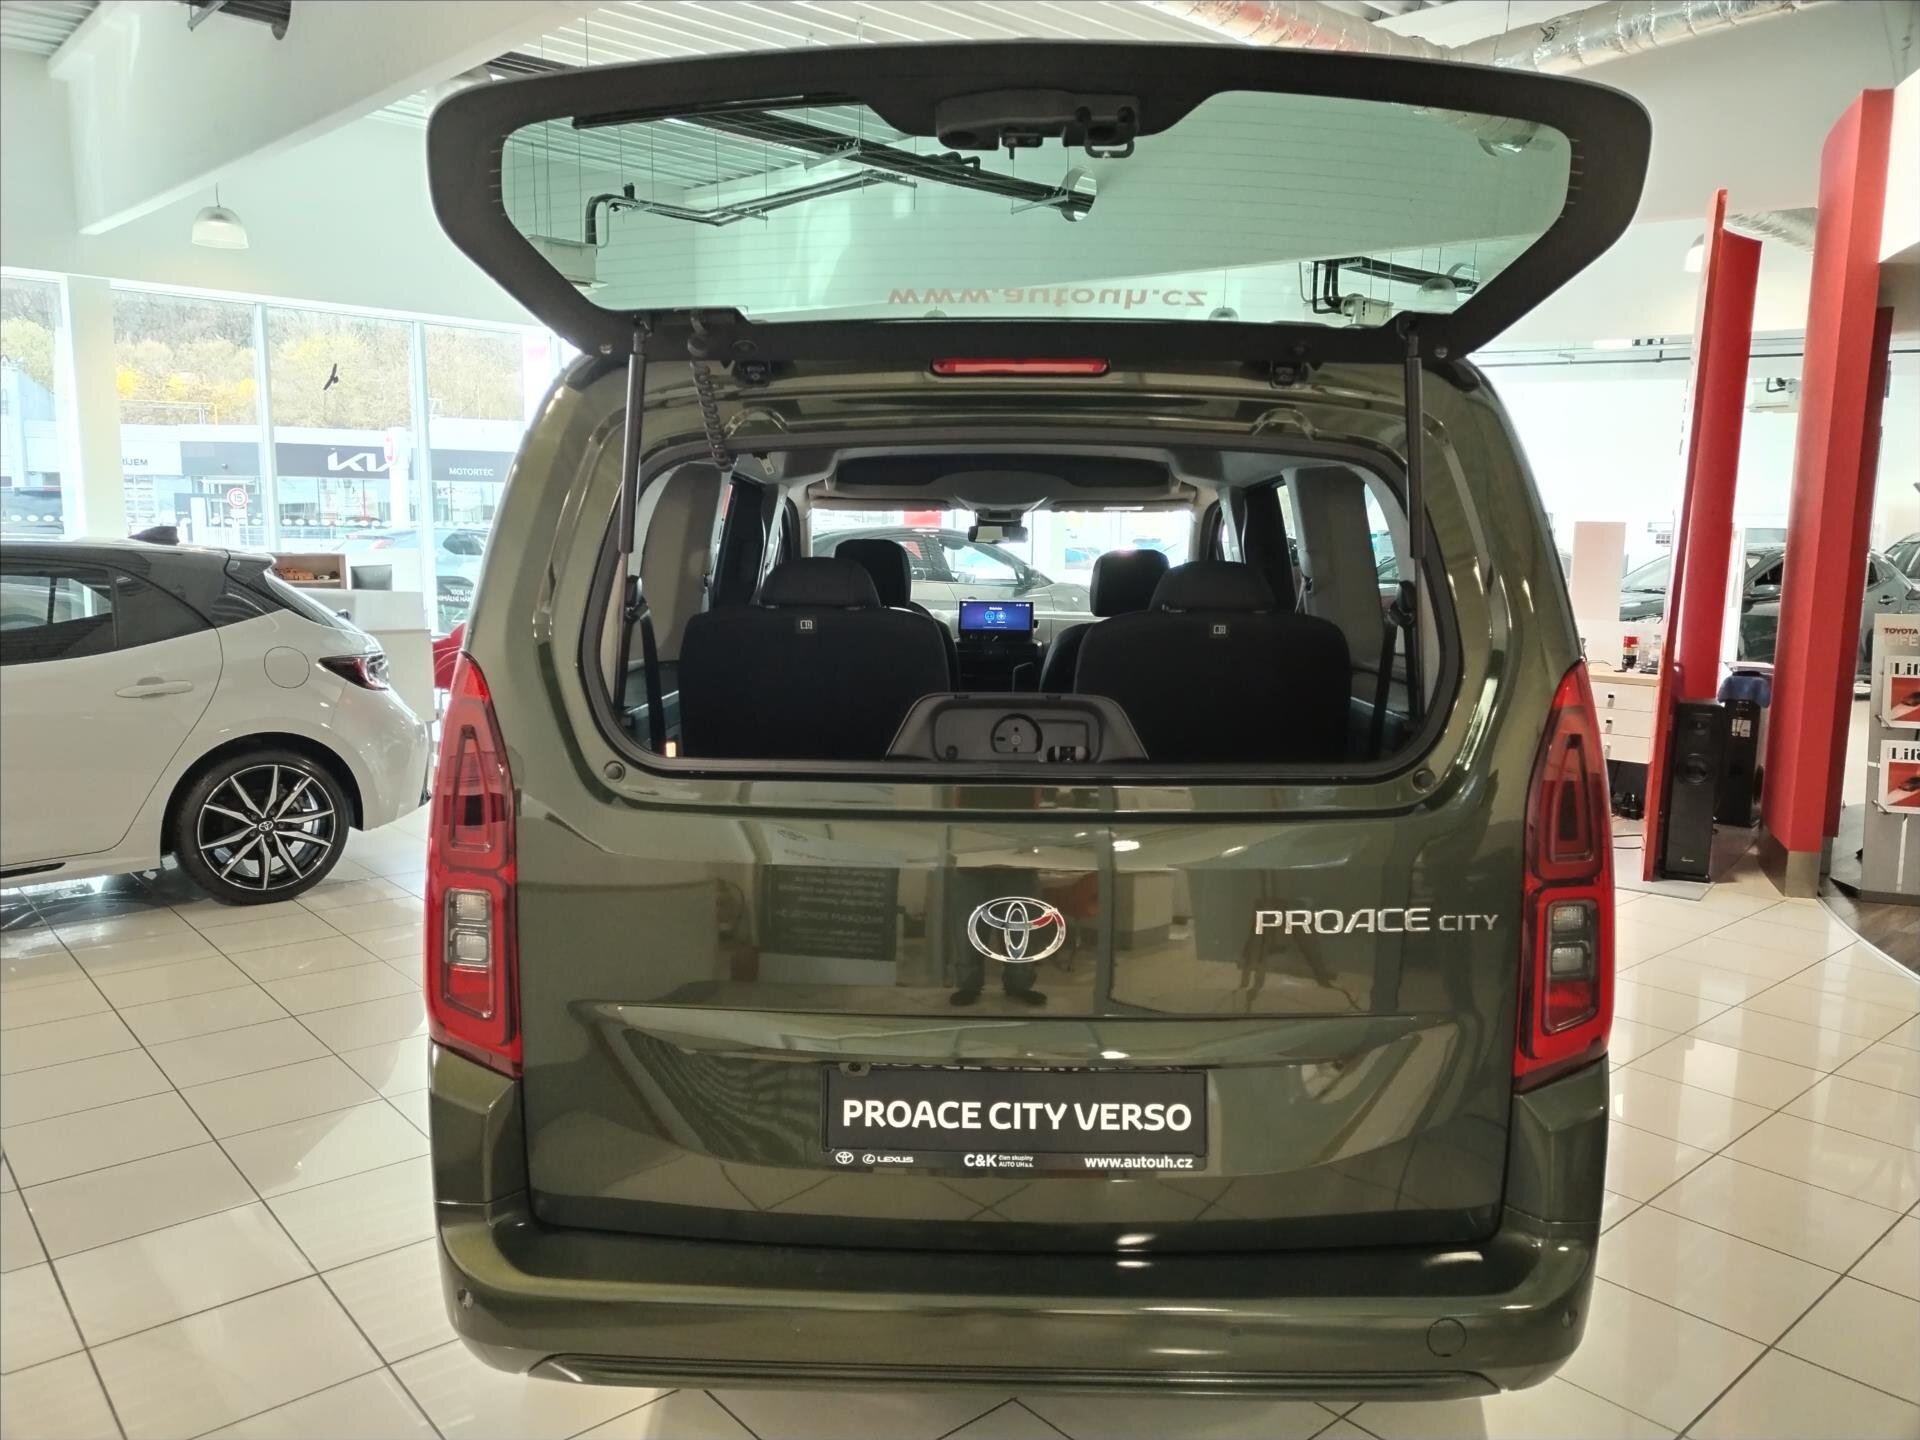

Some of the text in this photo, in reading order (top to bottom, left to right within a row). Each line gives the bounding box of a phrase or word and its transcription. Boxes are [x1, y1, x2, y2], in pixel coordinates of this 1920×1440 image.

[449, 467, 494, 476] MOTORTEC
[1255, 908, 1499, 935] PROACE CITY
[843, 1100, 1192, 1132] PROACE CITY VERSO
[964, 1154, 997, 1167] C&K
[1084, 1155, 1193, 1168] www.autouh.cz
